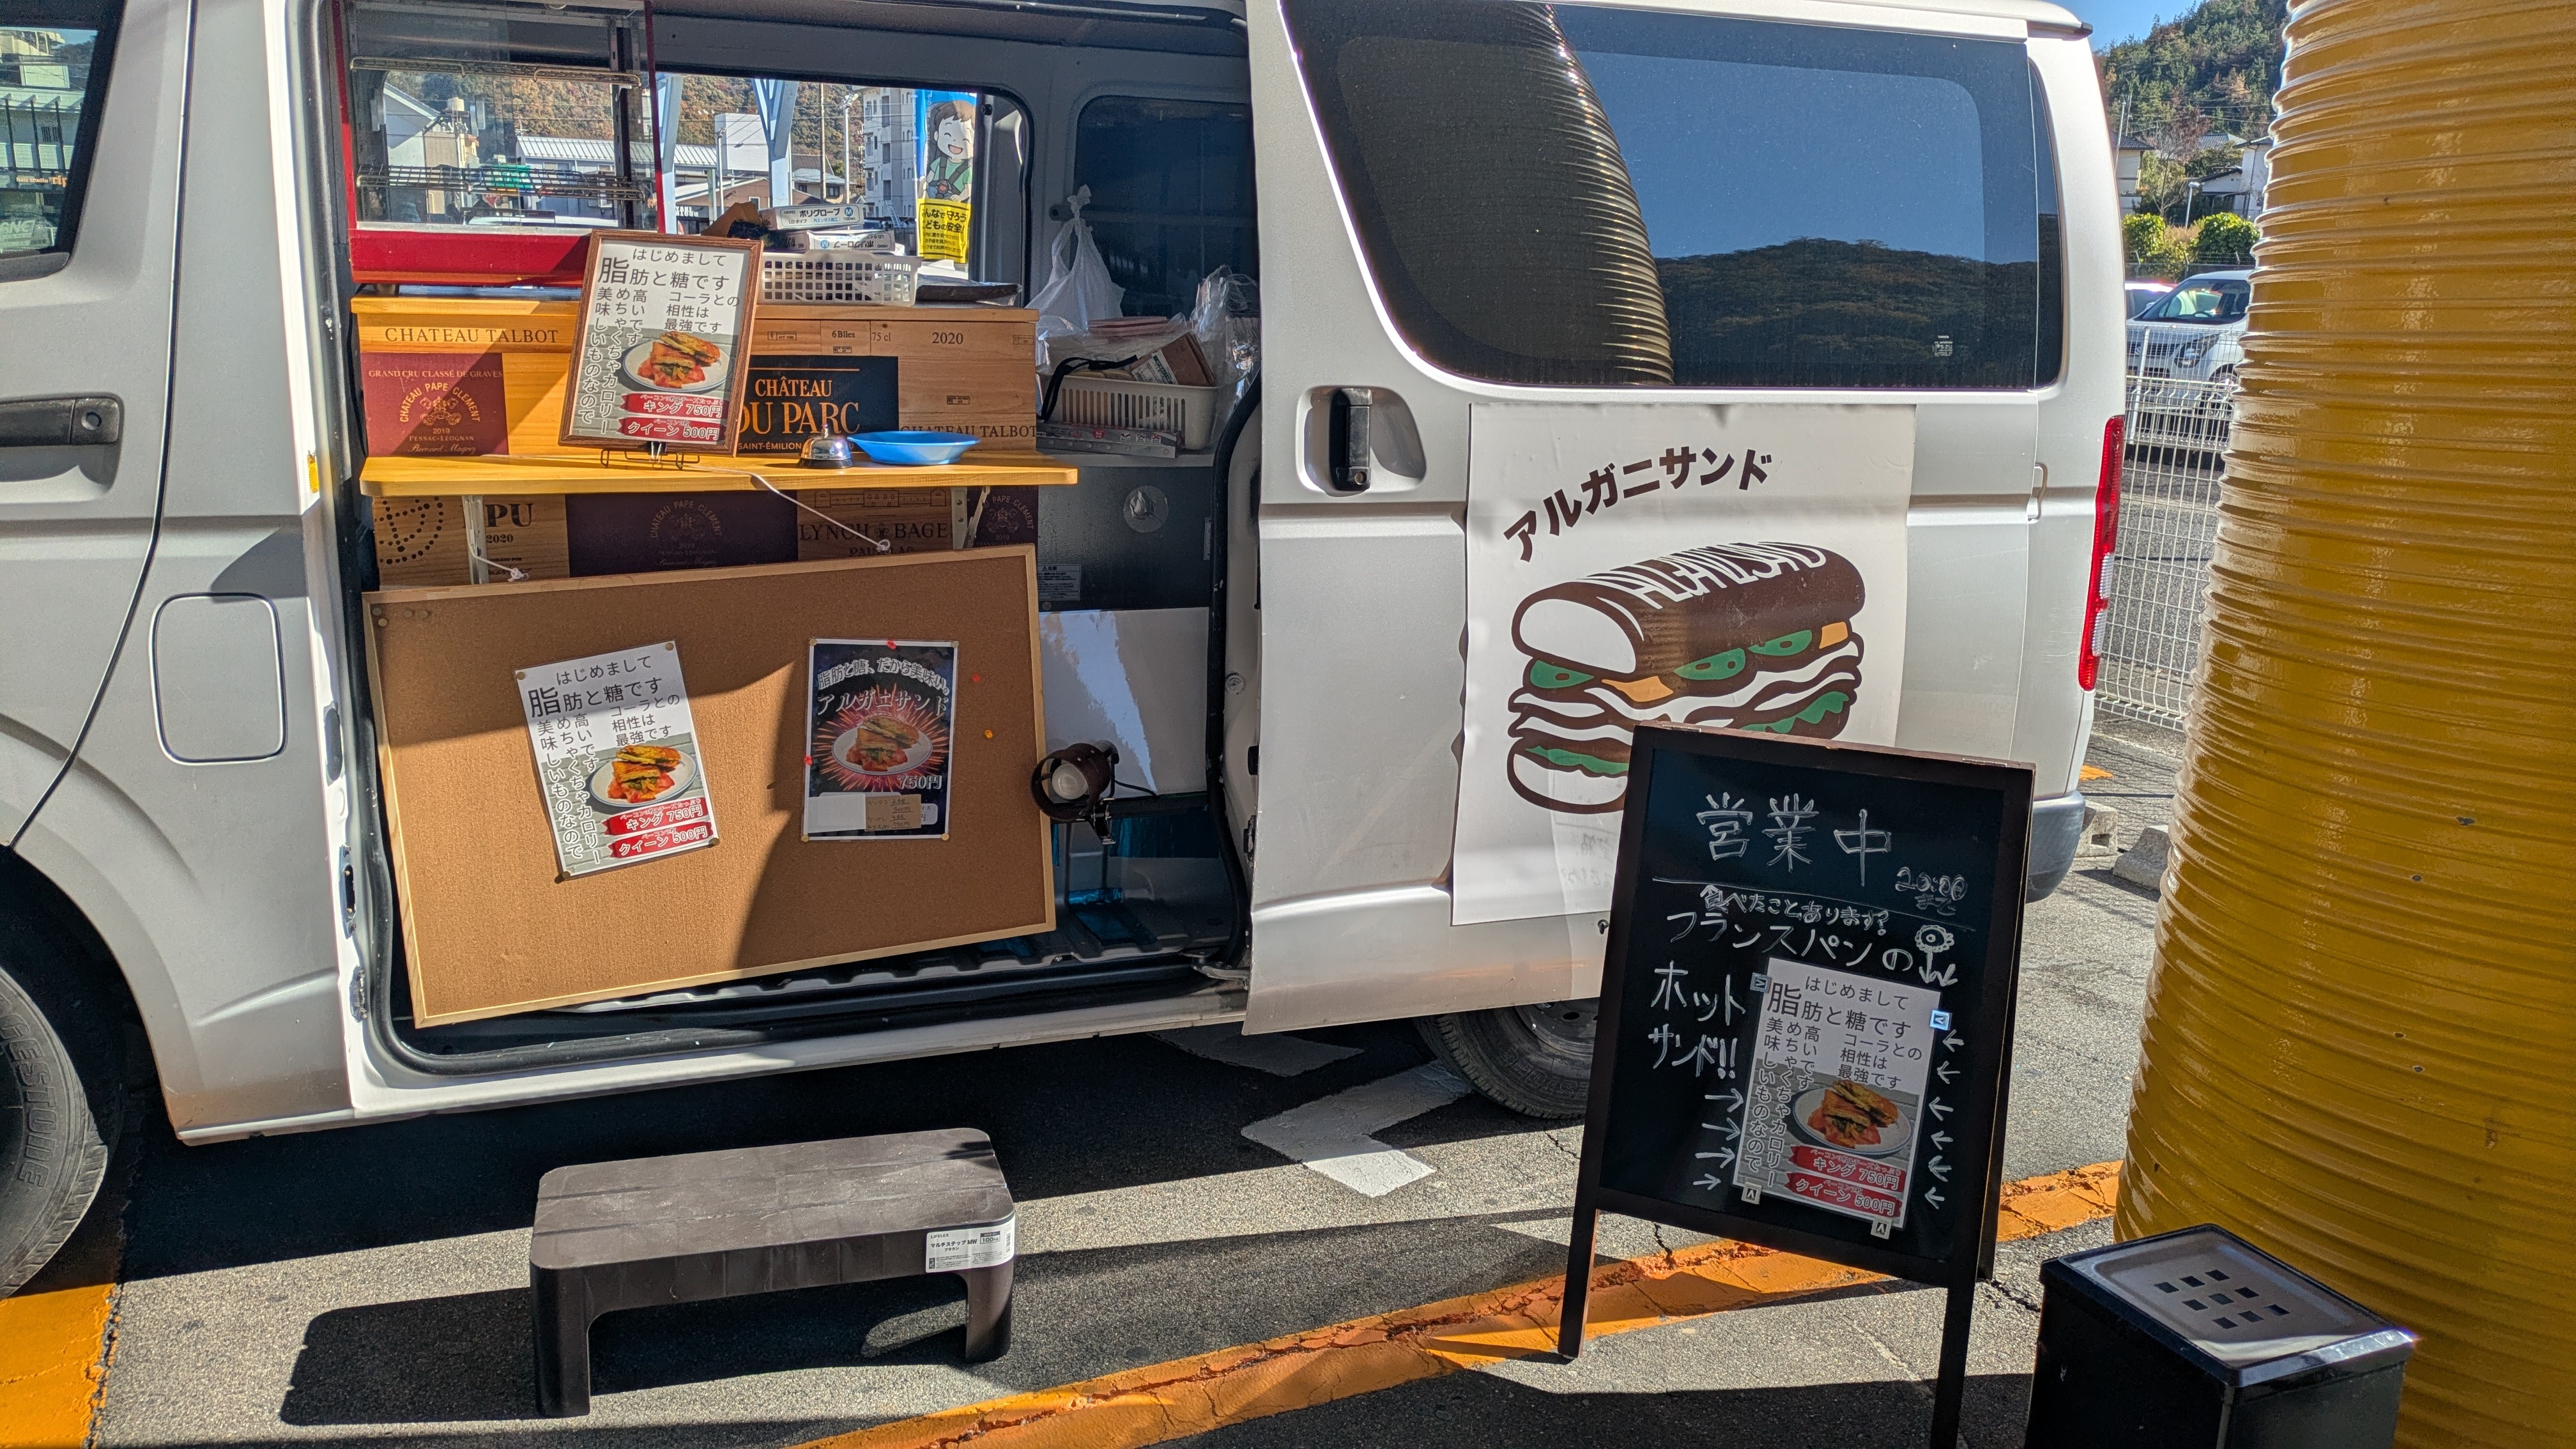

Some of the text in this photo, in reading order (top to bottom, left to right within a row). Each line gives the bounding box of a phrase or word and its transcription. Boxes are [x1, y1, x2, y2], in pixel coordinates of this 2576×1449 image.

[799, 208, 840, 218] ポリグローブ
[632, 249, 726, 266] はじめまして
[597, 257, 730, 291] 脂肪と糖です
[665, 304, 709, 318] 相性は
[670, 291, 740, 307] コーラとの
[627, 289, 647, 346] 高いです
[664, 319, 722, 334] 最強です
[385, 328, 558, 343] CHATEAU TALBOT
[871, 332, 881, 341] 75
[931, 332, 963, 344] 2020
[578, 288, 613, 424] 美味しいものなので
[422, 369, 454, 378] CLASSÉ
[755, 375, 832, 397] CHÂTEAU
[399, 382, 480, 422] CHATEAU PAPE CLEMENT
[644, 401, 723, 418] キング 750円
[783, 402, 861, 434] PARC
[628, 422, 719, 440] クイーン 500円
[980, 425, 1036, 438] TALBOT
[738, 441, 801, 450] SAINT-ÉMILION
[461, 503, 534, 528] PU
[992, 495, 1034, 530] PAPE CLEMENT
[1503, 446, 1772, 562] アルガニサンド
[486, 534, 514, 543] 2020
[800, 523, 949, 540] LYNCH BAGE
[556, 656, 652, 686] はじめまして
[528, 677, 662, 717] 脂肪と糖です
[610, 694, 680, 718] コーラとの
[612, 713, 656, 733] 相性は
[615, 724, 671, 747] 最強です
[574, 713, 599, 772] 高いです
[537, 721, 583, 859] 美味しいものなので
[896, 775, 942, 790] 750円
[626, 804, 703, 831] キング 750円
[619, 826, 707, 856] クイーン 500円
[1696, 792, 1892, 887] 営業中
[1667, 911, 1913, 972] フランスパンの
[1650, 961, 1746, 1025] ホット
[1805, 976, 1909, 1011] はじめまして
[1767, 982, 1912, 1039] 脂肪と糖です
[1797, 1025, 1821, 1091] 高いです
[1840, 1047, 1887, 1070] 相性は
[1843, 1032, 1922, 1061] コーラとの
[1838, 1065, 1901, 1089] 最強です
[1744, 1017, 1784, 1173] 美味しいものなので
[1813, 1157, 1899, 1190] キング 750円
[1796, 1179, 1895, 1216] クイーン 500円
[930, 1239, 966, 1248] マルチステップ
